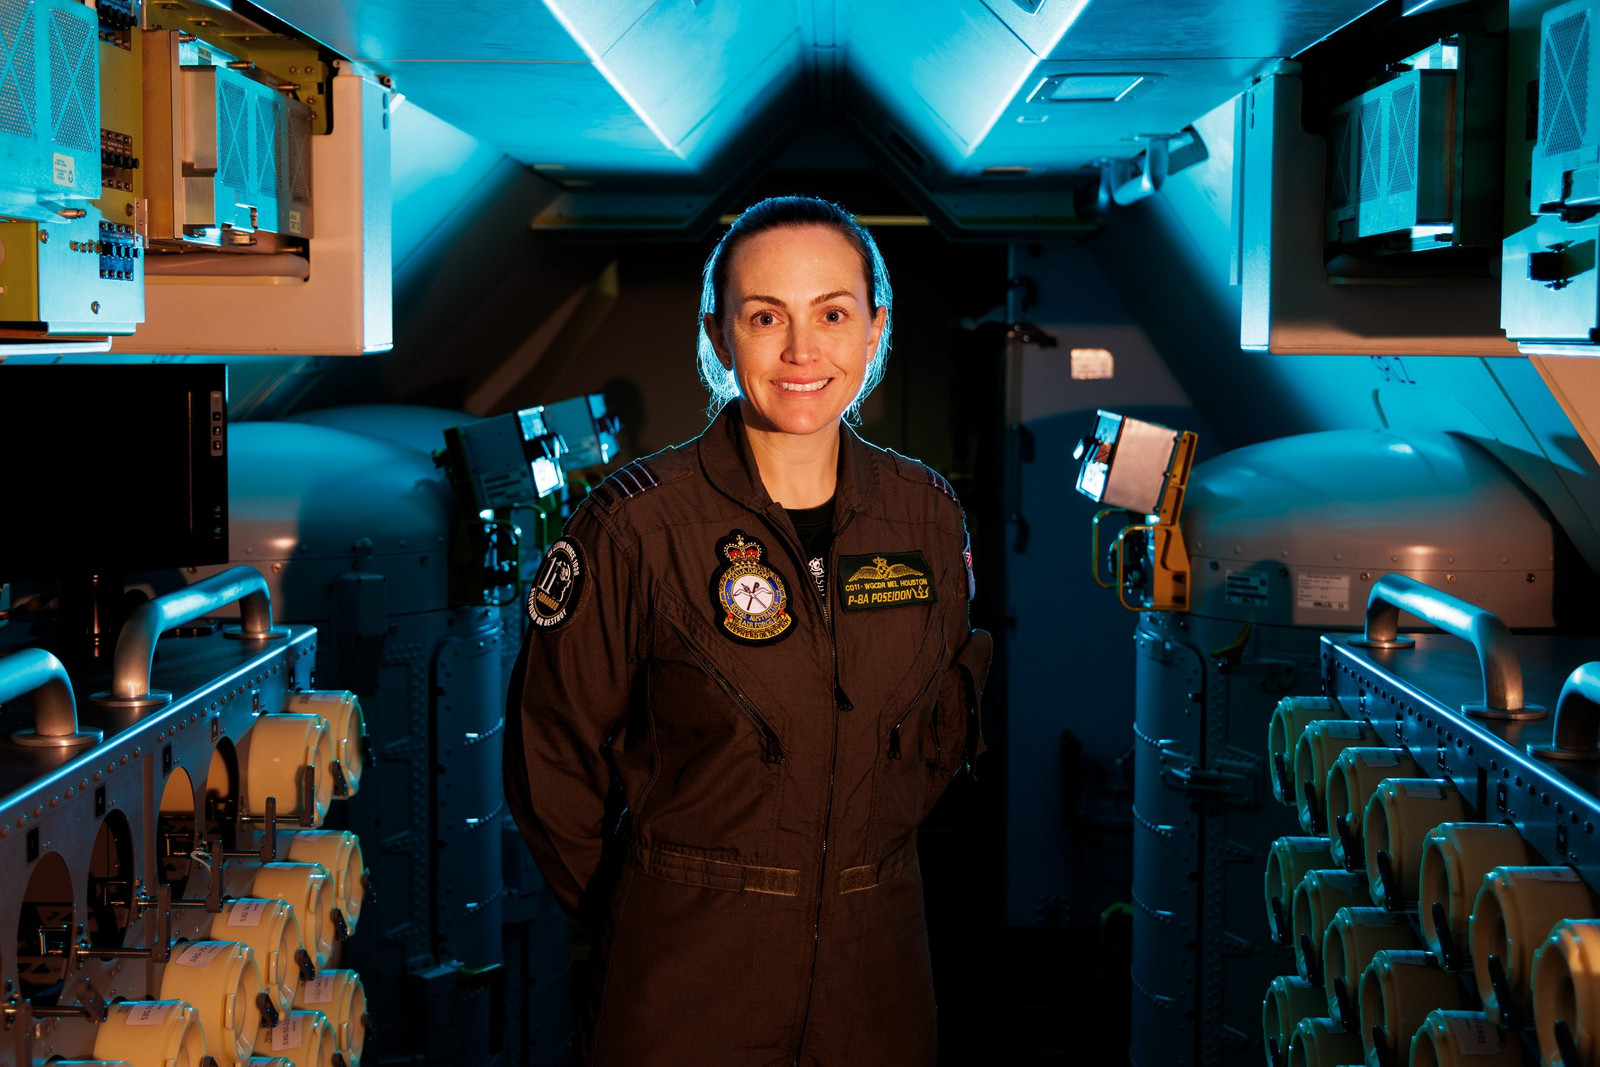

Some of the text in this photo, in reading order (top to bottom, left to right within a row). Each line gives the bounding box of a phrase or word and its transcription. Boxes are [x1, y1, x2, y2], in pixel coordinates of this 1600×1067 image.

[537, 557, 563, 595] 11
[729, 567, 770, 580] SQUADRON
[864, 581, 887, 590] WGCDR
[887, 580, 899, 588] MEL
[900, 578, 928, 587] HOUSTON
[848, 588, 912, 606] P-8A POSEIDON
[528, 587, 567, 627] SHEPHERD OR DESTROY
[730, 602, 780, 621] ROYAL AUSTRALIAN
[725, 622, 758, 639] SHEPHERD
[768, 618, 790, 636] DESTROY
[742, 620, 753, 628] AIR
